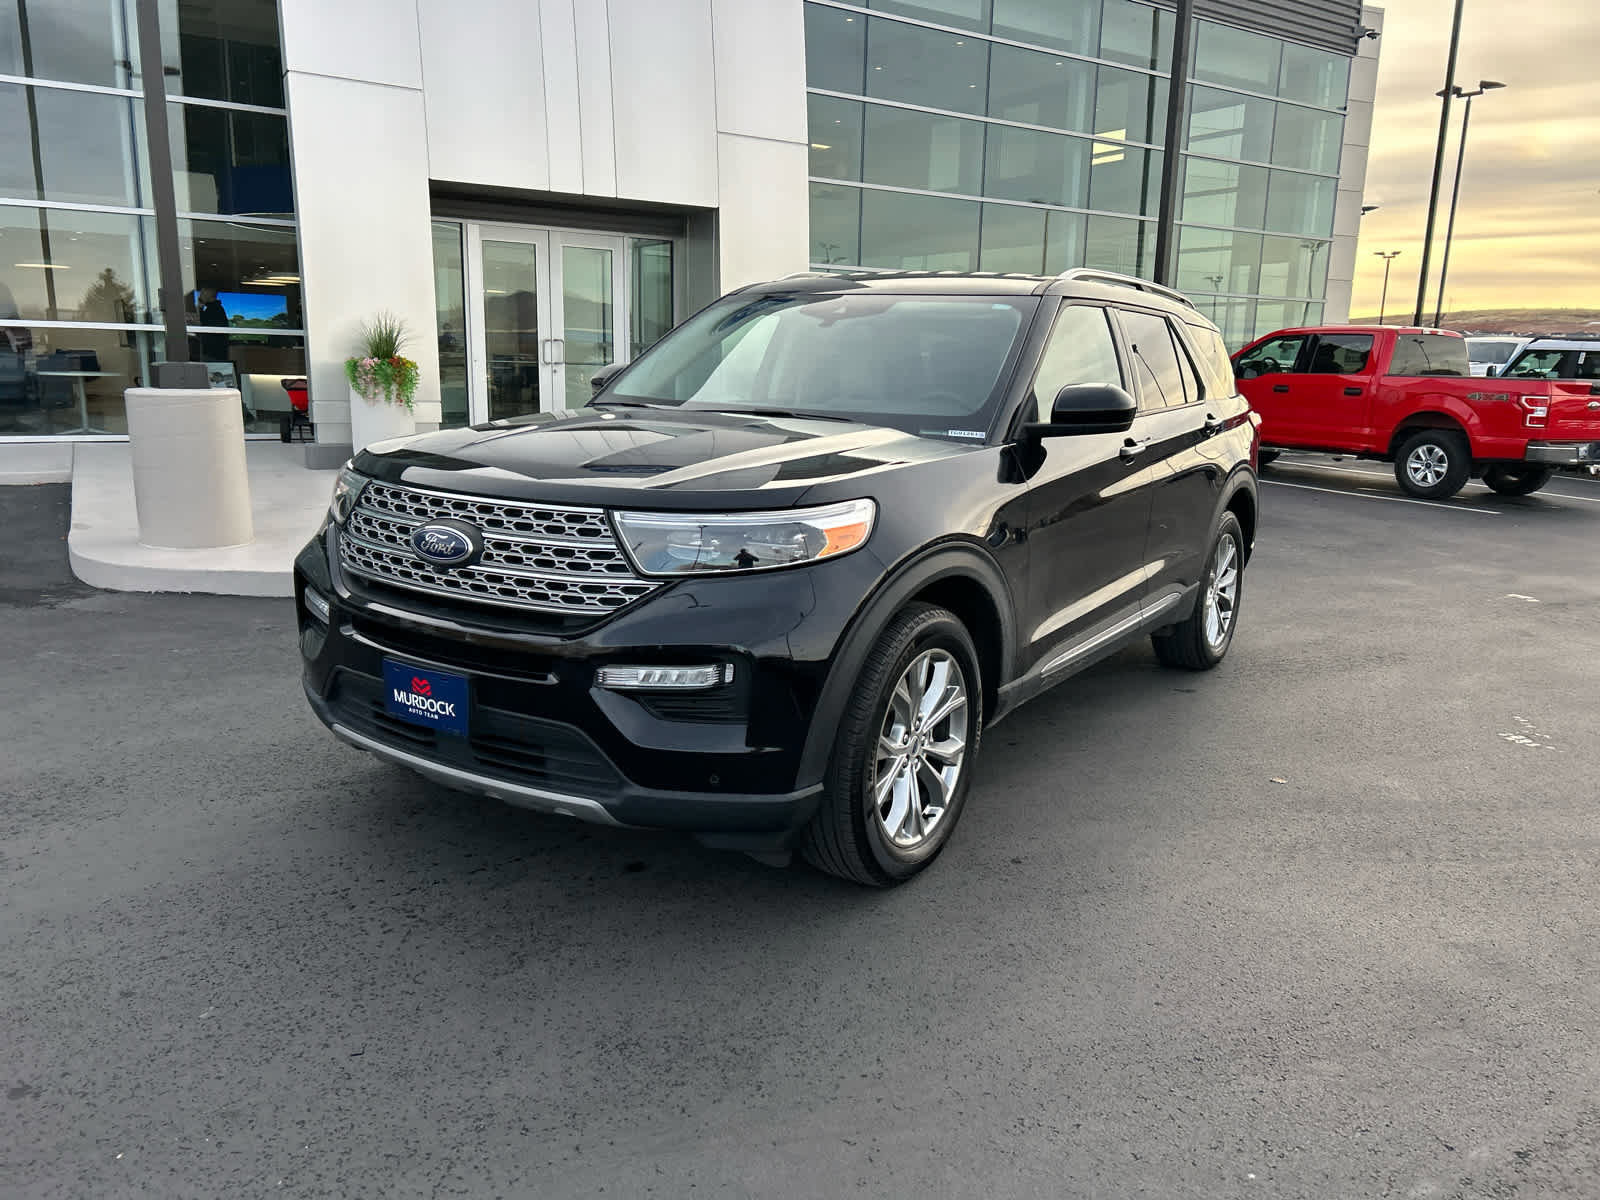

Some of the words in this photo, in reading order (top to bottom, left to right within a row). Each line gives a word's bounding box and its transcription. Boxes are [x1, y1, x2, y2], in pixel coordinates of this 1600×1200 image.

[421, 532, 456, 555] Ford
[393, 688, 456, 717] MURDOCK
[408, 707, 423, 716] AUTO
[424, 711, 439, 720] TEAM
